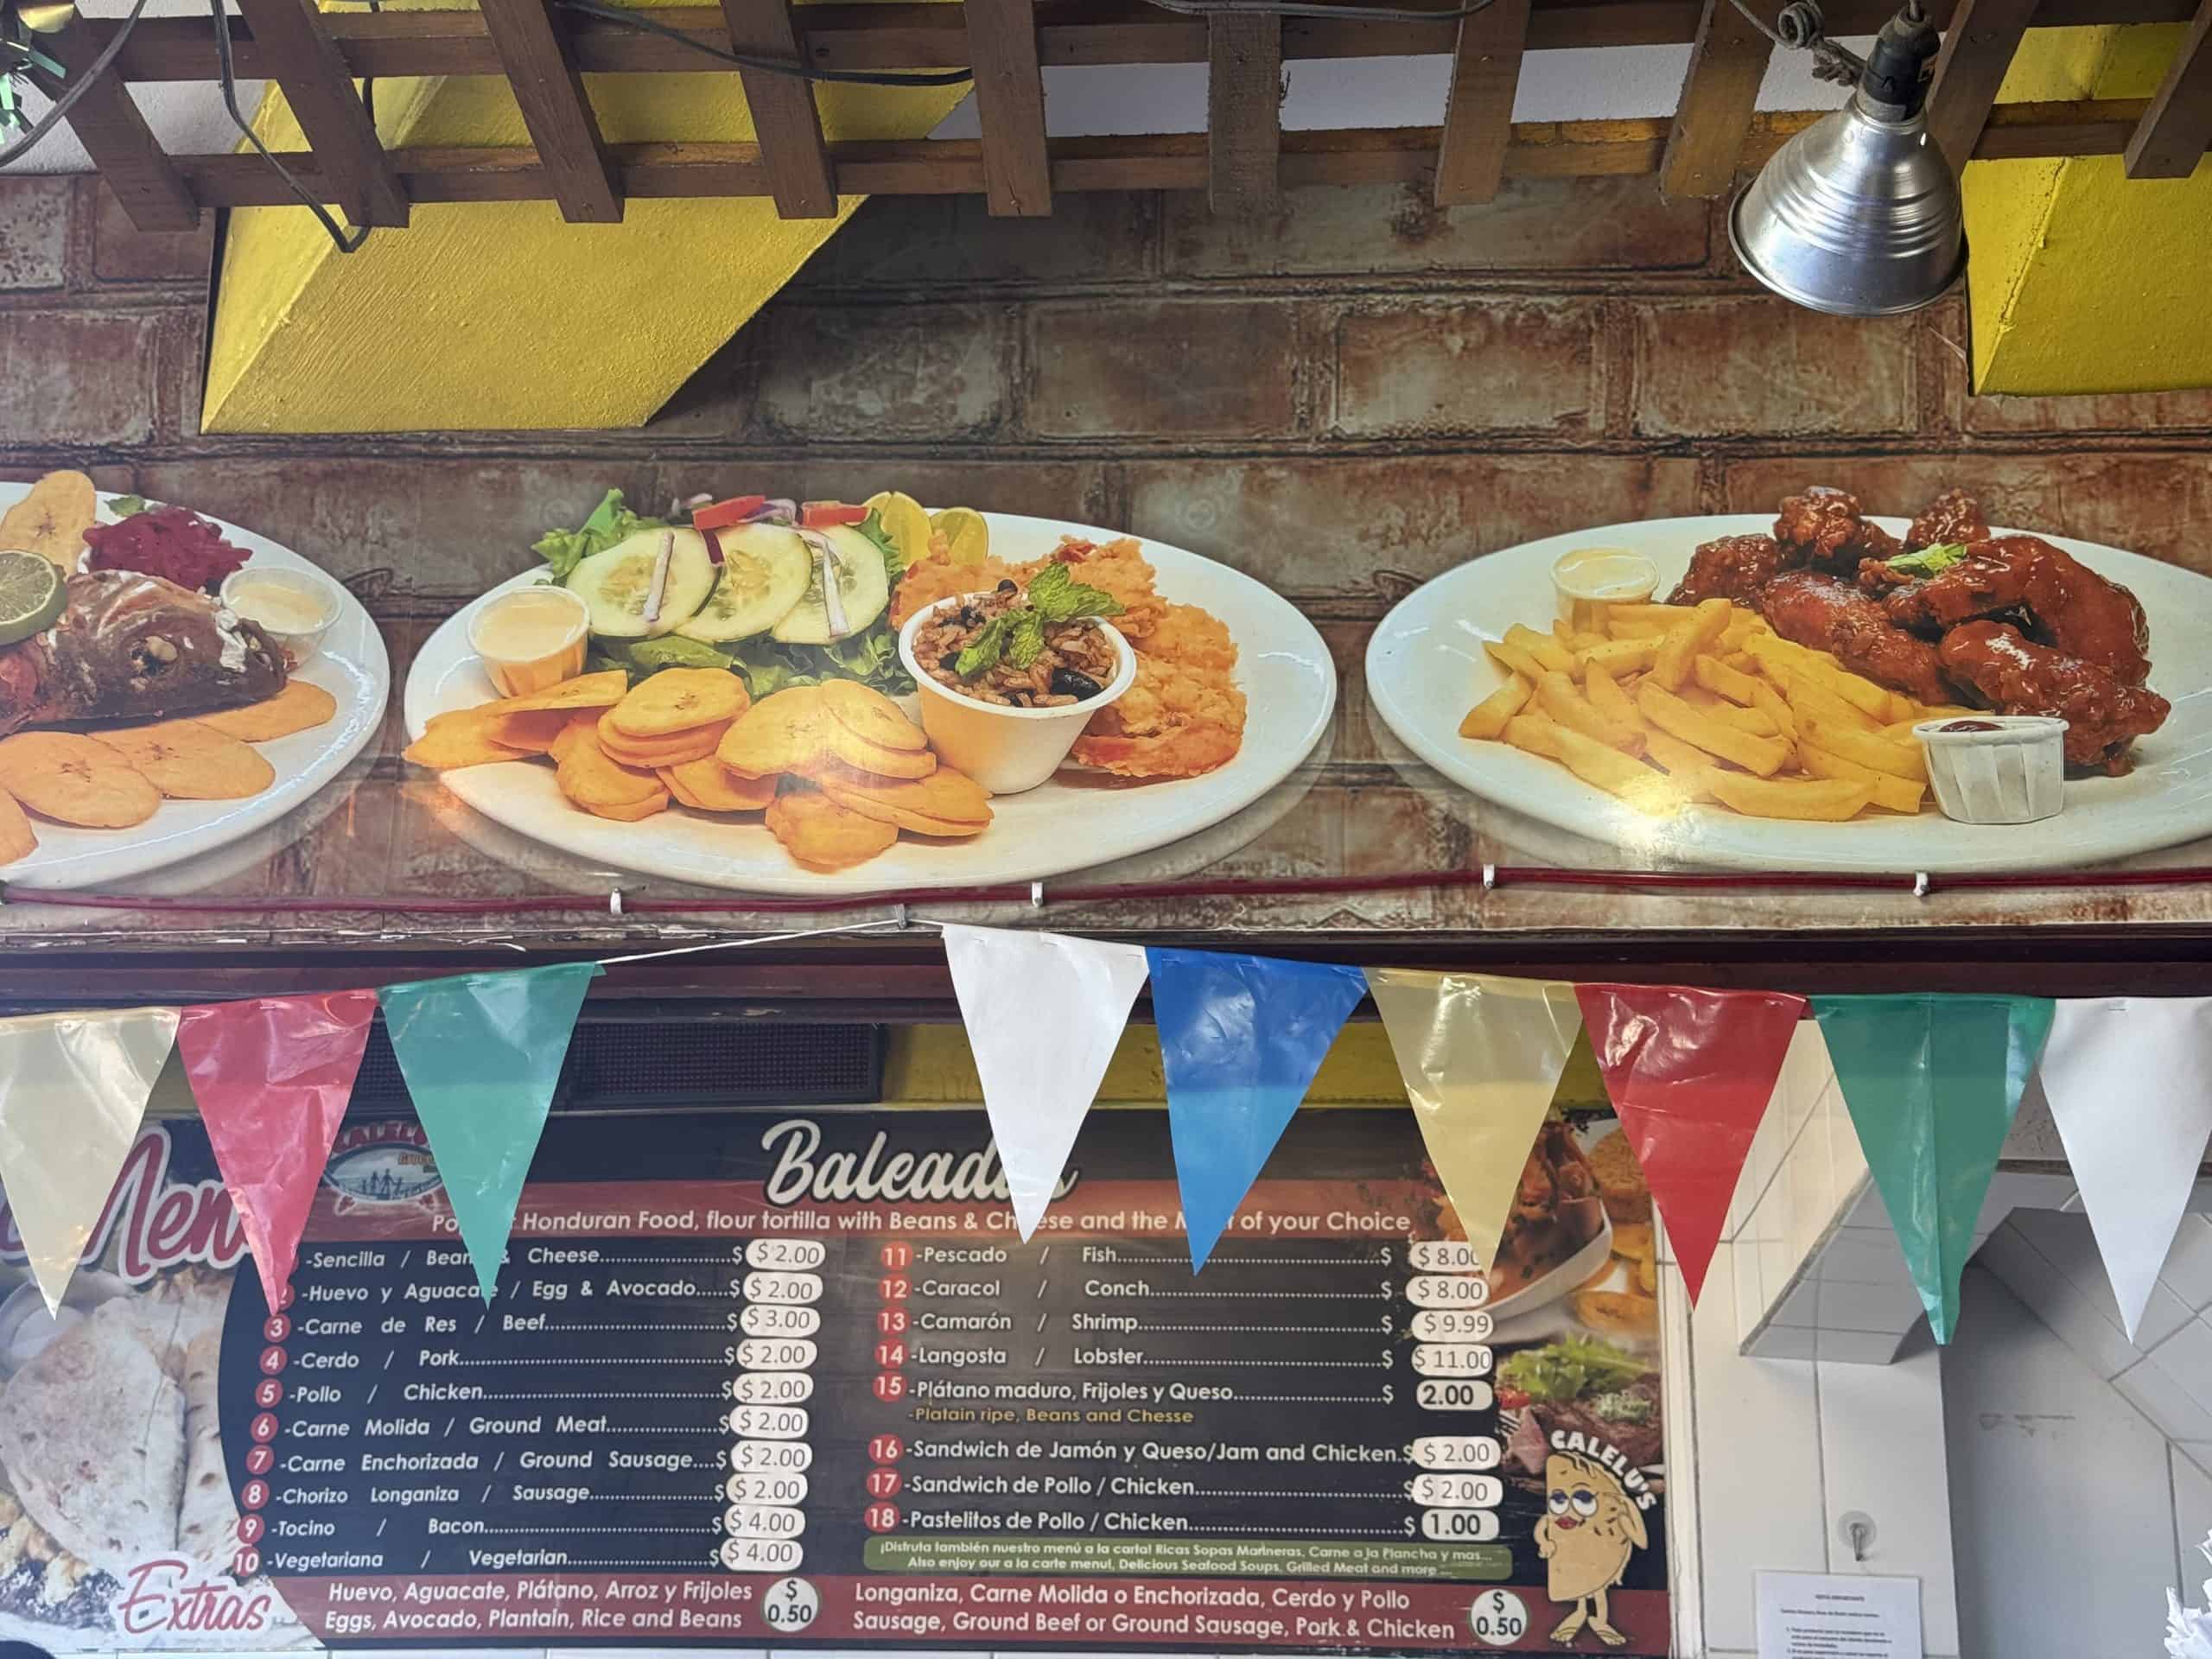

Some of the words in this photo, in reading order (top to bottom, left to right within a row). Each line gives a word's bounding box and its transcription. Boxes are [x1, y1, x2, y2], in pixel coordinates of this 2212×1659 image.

[523, 1211, 631, 1230] Honduran
[638, 1210, 700, 1230] Food,
[707, 1210, 754, 1229] flour
[762, 1210, 830, 1230] tortilla
[837, 1211, 882, 1230] with
[889, 1212, 957, 1230] Beans
[986, 1211, 1074, 1230] Chese
[1080, 1211, 1124, 1230] and
[1131, 1211, 1168, 1230] the
[1240, 1211, 1263, 1230] of
[1269, 1215, 1320, 1235] your
[1326, 1211, 1411, 1231] Choice
[426, 1249, 474, 1267] Bean
[883, 1247, 907, 1264] 11
[404, 1283, 499, 1303] Aguacae
[532, 1281, 568, 1300] Egg
[882, 1280, 907, 1298] 12
[381, 1316, 407, 1333] de
[424, 1316, 457, 1333] Res
[880, 1313, 906, 1332] 13
[879, 1344, 906, 1364] 14
[876, 1376, 903, 1396] 15
[1082, 1382, 1148, 1403] Frijoles
[1423, 1384, 1474, 1406] 2.00
[365, 1418, 430, 1436] Molida
[469, 1416, 541, 1434] Ground
[1026, 1408, 1081, 1422] Beans
[1085, 1409, 1122, 1422] and
[1127, 1408, 1195, 1423] Chesse
[361, 1452, 480, 1471] Enchorizada
[519, 1450, 594, 1469] Ground
[874, 1440, 899, 1459] 16
[1015, 1440, 1042, 1459] de
[1049, 1440, 1116, 1459] Jamón
[1265, 1444, 1306, 1462] and
[370, 1484, 460, 1506] Longaniza
[871, 1473, 899, 1494] 17
[1013, 1476, 1039, 1494] de
[1044, 1477, 1092, 1495] Pollo
[869, 1508, 895, 1529] 18
[1006, 1511, 1033, 1529] de
[1038, 1511, 1085, 1530] Pollo
[1430, 1513, 1481, 1535] 1.00
[935, 1541, 989, 1554] también
[993, 1541, 1041, 1554] nuestro
[1155, 1544, 1190, 1556] Ricas
[1193, 1544, 1233, 1558] Sopas
[1382, 1548, 1438, 1560] Plancha
[234, 1554, 259, 1573] 10
[908, 1557, 936, 1568] Also
[938, 1558, 976, 1570] enjoy
[979, 1560, 1001, 1569] our
[1119, 1558, 1179, 1571] Delicious
[1181, 1559, 1237, 1572] Seafood
[1339, 1561, 1370, 1574] Meat
[1371, 1562, 1398, 1575] and
[118, 1558, 272, 1635] Extras
[328, 1582, 397, 1603] Huevo,
[404, 1580, 510, 1604] Aguacate,
[605, 1580, 658, 1599] Arroz
[683, 1580, 753, 1605] Frijoles
[855, 1582, 963, 1605] Longaniza,
[969, 1583, 1033, 1603] Carne
[1038, 1584, 1108, 1604] Molida
[1134, 1586, 1266, 1608] Enchorizada,
[1271, 1587, 1337, 1608] Cerdo
[1361, 1589, 1410, 1610] Pollo
[324, 1610, 378, 1633] Eggs,
[383, 1608, 482, 1631] Avocado,
[488, 1607, 575, 1630] Plantain,
[581, 1608, 626, 1628] Rice
[632, 1608, 673, 1628] and
[679, 1609, 742, 1629] Beans
[853, 1610, 947, 1635] Sausage,
[952, 1611, 1029, 1631] Ground
[1036, 1612, 1081, 1631] Beef
[1085, 1618, 1107, 1632] or
[1112, 1613, 1190, 1633] Ground
[1195, 1614, 1289, 1639] Sausage,
[1295, 1616, 1341, 1637] Pork
[1367, 1618, 1455, 1639] Chicken
